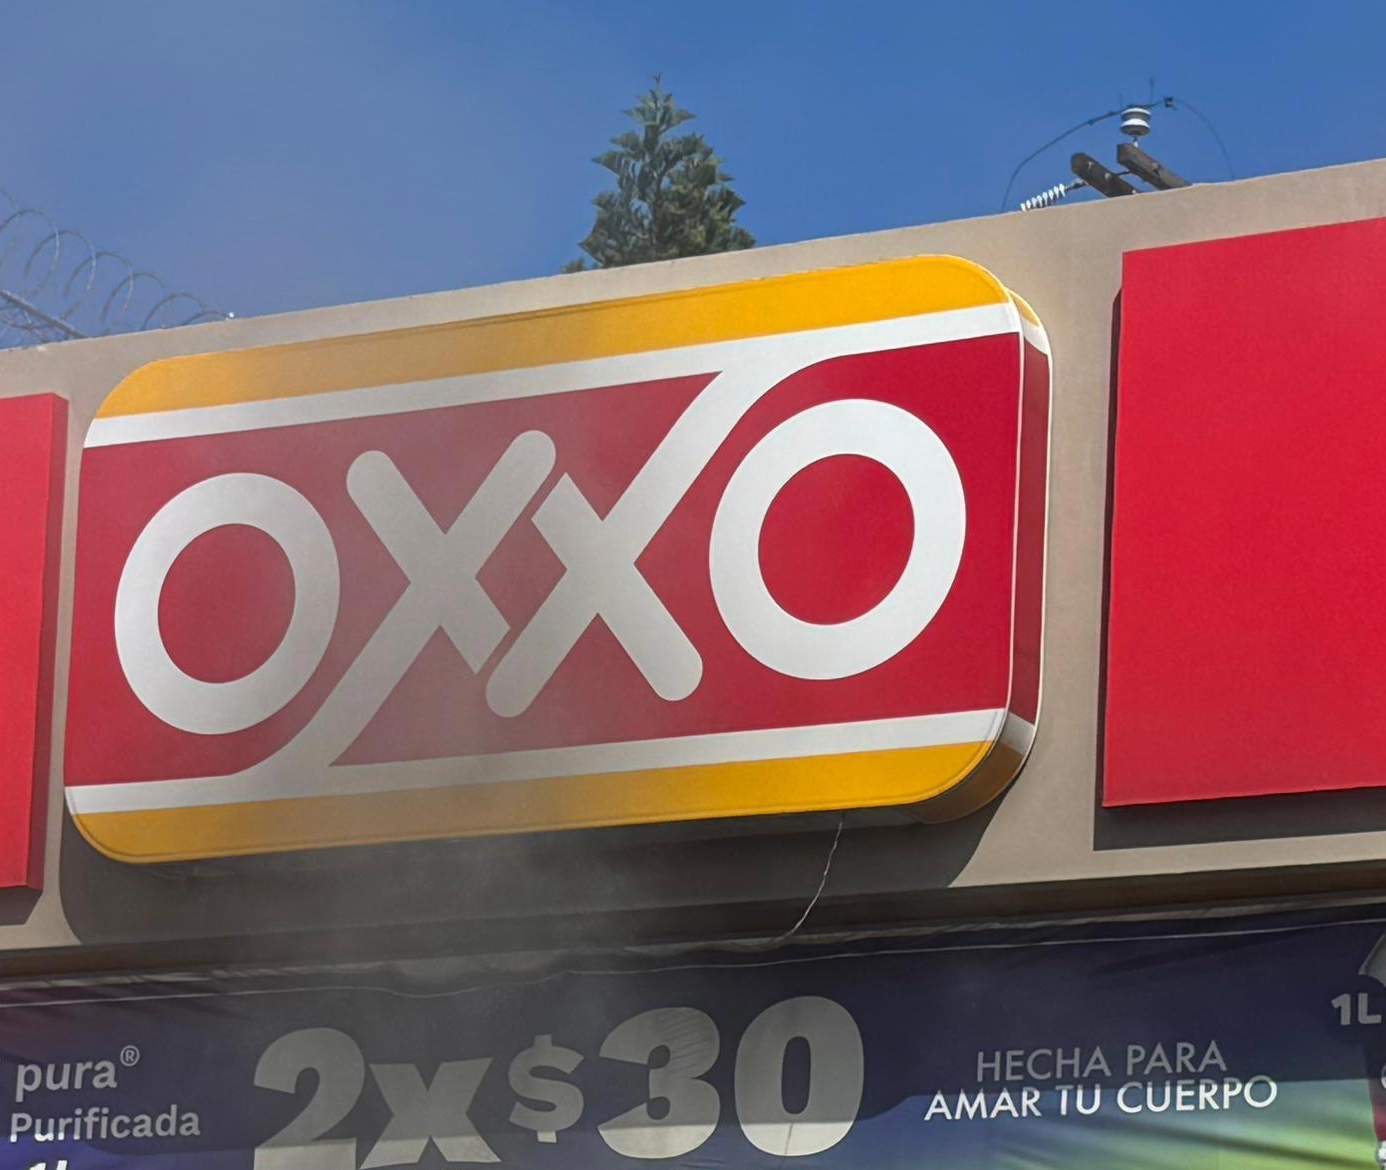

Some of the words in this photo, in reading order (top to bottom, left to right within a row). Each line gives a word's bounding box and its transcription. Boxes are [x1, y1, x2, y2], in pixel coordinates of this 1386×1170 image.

[115, 372, 966, 766] OXXO
[1331, 992, 1382, 1026] 1L
[976, 1046, 1105, 1082] HECHA
[1125, 1040, 1227, 1076] PARA
[923, 1086, 1048, 1122] AMAR
[1054, 1083, 1105, 1118] TU
[1115, 1074, 1278, 1114] CUERPO
[11, 1104, 201, 1143] Purificada
